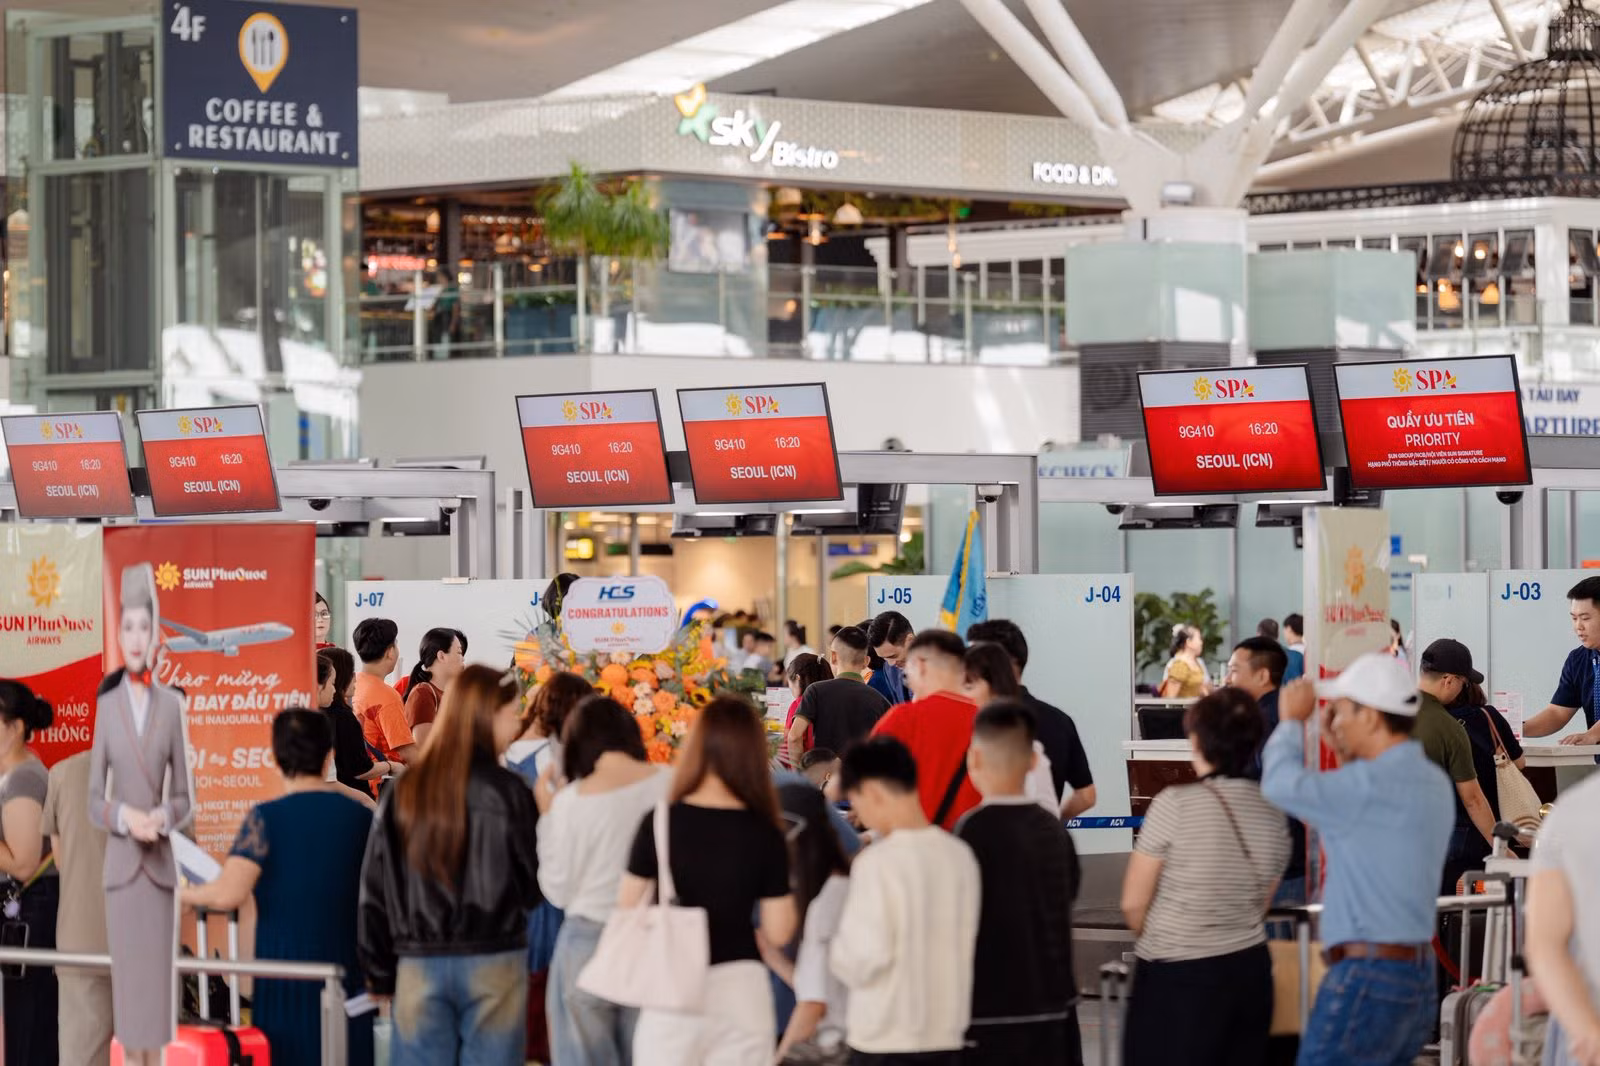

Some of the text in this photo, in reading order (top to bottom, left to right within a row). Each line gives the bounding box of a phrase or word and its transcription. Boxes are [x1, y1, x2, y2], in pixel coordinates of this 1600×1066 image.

[171, 6, 206, 41] 4F
[205, 97, 323, 128] COFFEE &
[188, 123, 341, 155] RESTAURANT
[771, 140, 839, 169] Bistro
[1032, 162, 1078, 184] FOOD
[1078, 165, 1090, 185] &
[1415, 369, 1457, 391] SPA
[1215, 379, 1256, 399] SPA
[579, 401, 614, 420] SPA
[744, 395, 780, 414] SPA
[193, 416, 223, 433] SPA
[1387, 410, 1475, 429] QUẦY ƯU TIÊN
[55, 422, 84, 439] SPA
[1178, 422, 1278, 438] 9G410 16:20
[714, 436, 800, 450] 9G410 16:20
[1405, 432, 1460, 447] PRIORITY
[551, 442, 632, 455] 9G410 16:20
[32, 459, 101, 471] 9G410 16:20
[169, 453, 242, 468] 9G410 16:20
[1196, 453, 1273, 470] SEOUL (ICN)
[566, 469, 629, 484] SEOUL (ICN)
[730, 465, 797, 480] SEOUL (ICN)
[46, 484, 99, 499] SEOUL (ICN)
[183, 479, 240, 494] SEOUL (ICN)
[183, 567, 210, 581] SUN
[355, 592, 385, 607] J-07
[877, 587, 912, 604] J-05
[1085, 585, 1121, 603] J-04
[1501, 582, 1541, 600] J-03
[567, 606, 669, 619] CONGRATULATIONS
[27, 636, 62, 646] AIRWAYS
[194, 694, 229, 711] BAY
[272, 690, 311, 709] TIÊN
[206, 712, 261, 725] INAUGURAL
